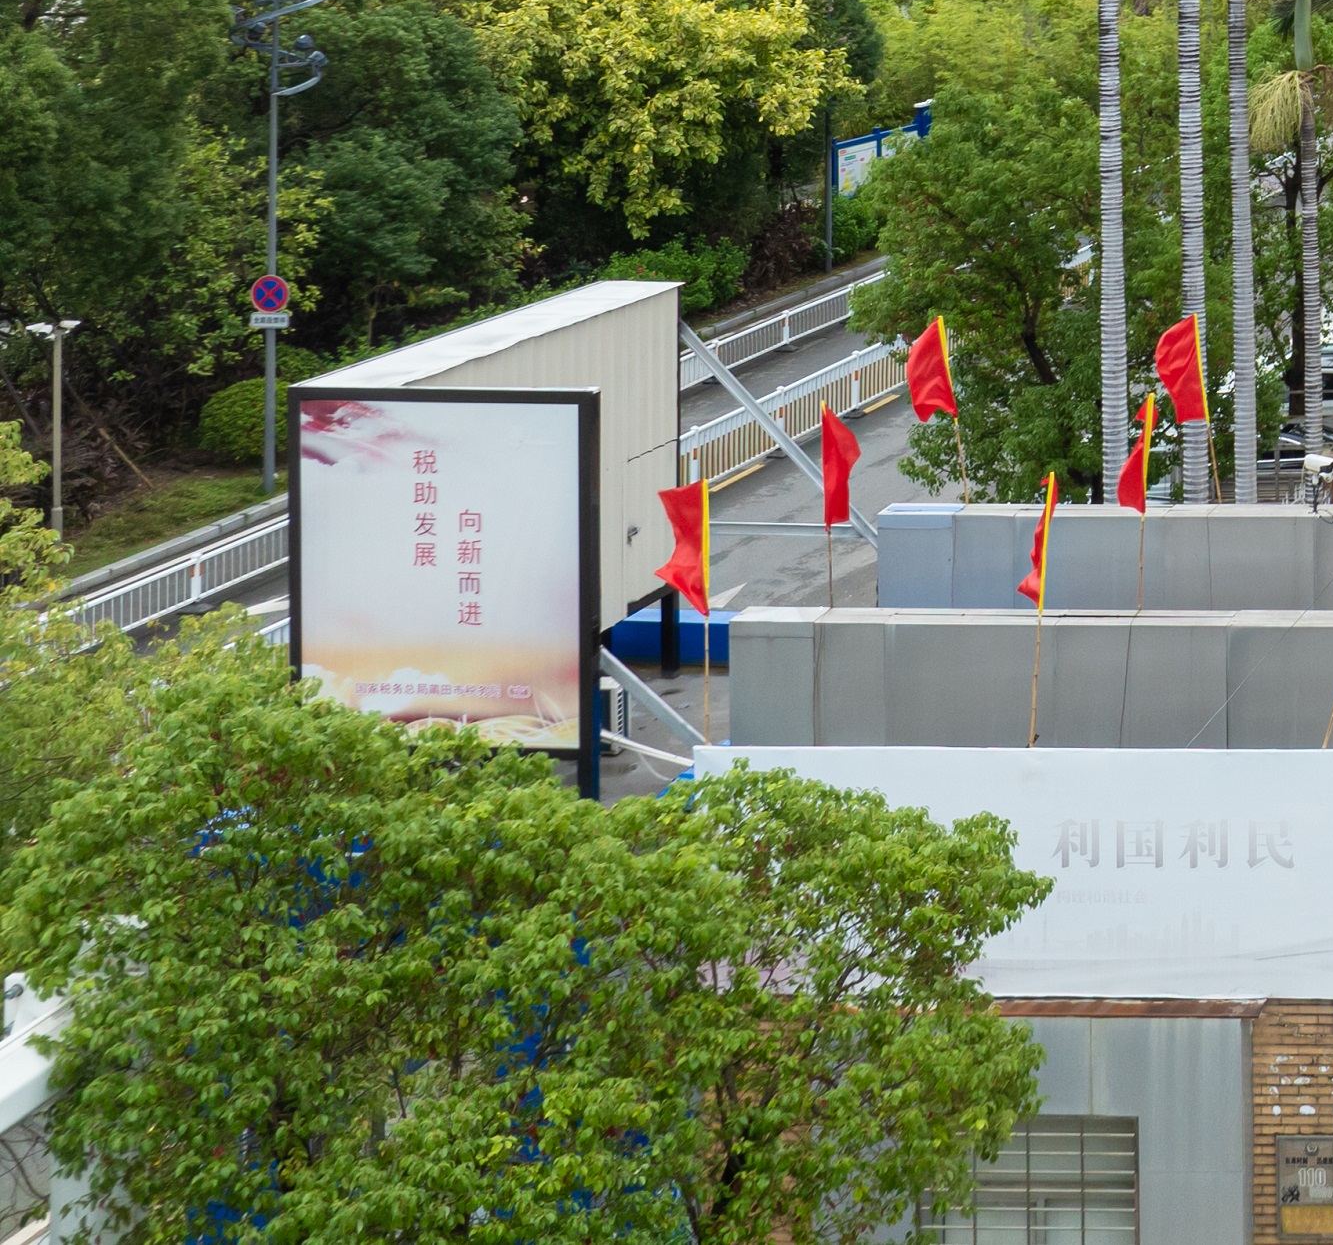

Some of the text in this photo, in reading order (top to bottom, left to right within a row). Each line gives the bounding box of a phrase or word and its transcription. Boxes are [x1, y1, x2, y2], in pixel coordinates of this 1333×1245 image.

[412, 449, 438, 567] 税助发展
[457, 509, 482, 626] 向新而进
[354, 681, 503, 699] 国家税务总局莆田市税务局
[1051, 818, 1296, 869] 利国利民
[1298, 1167, 1327, 1187] 110
